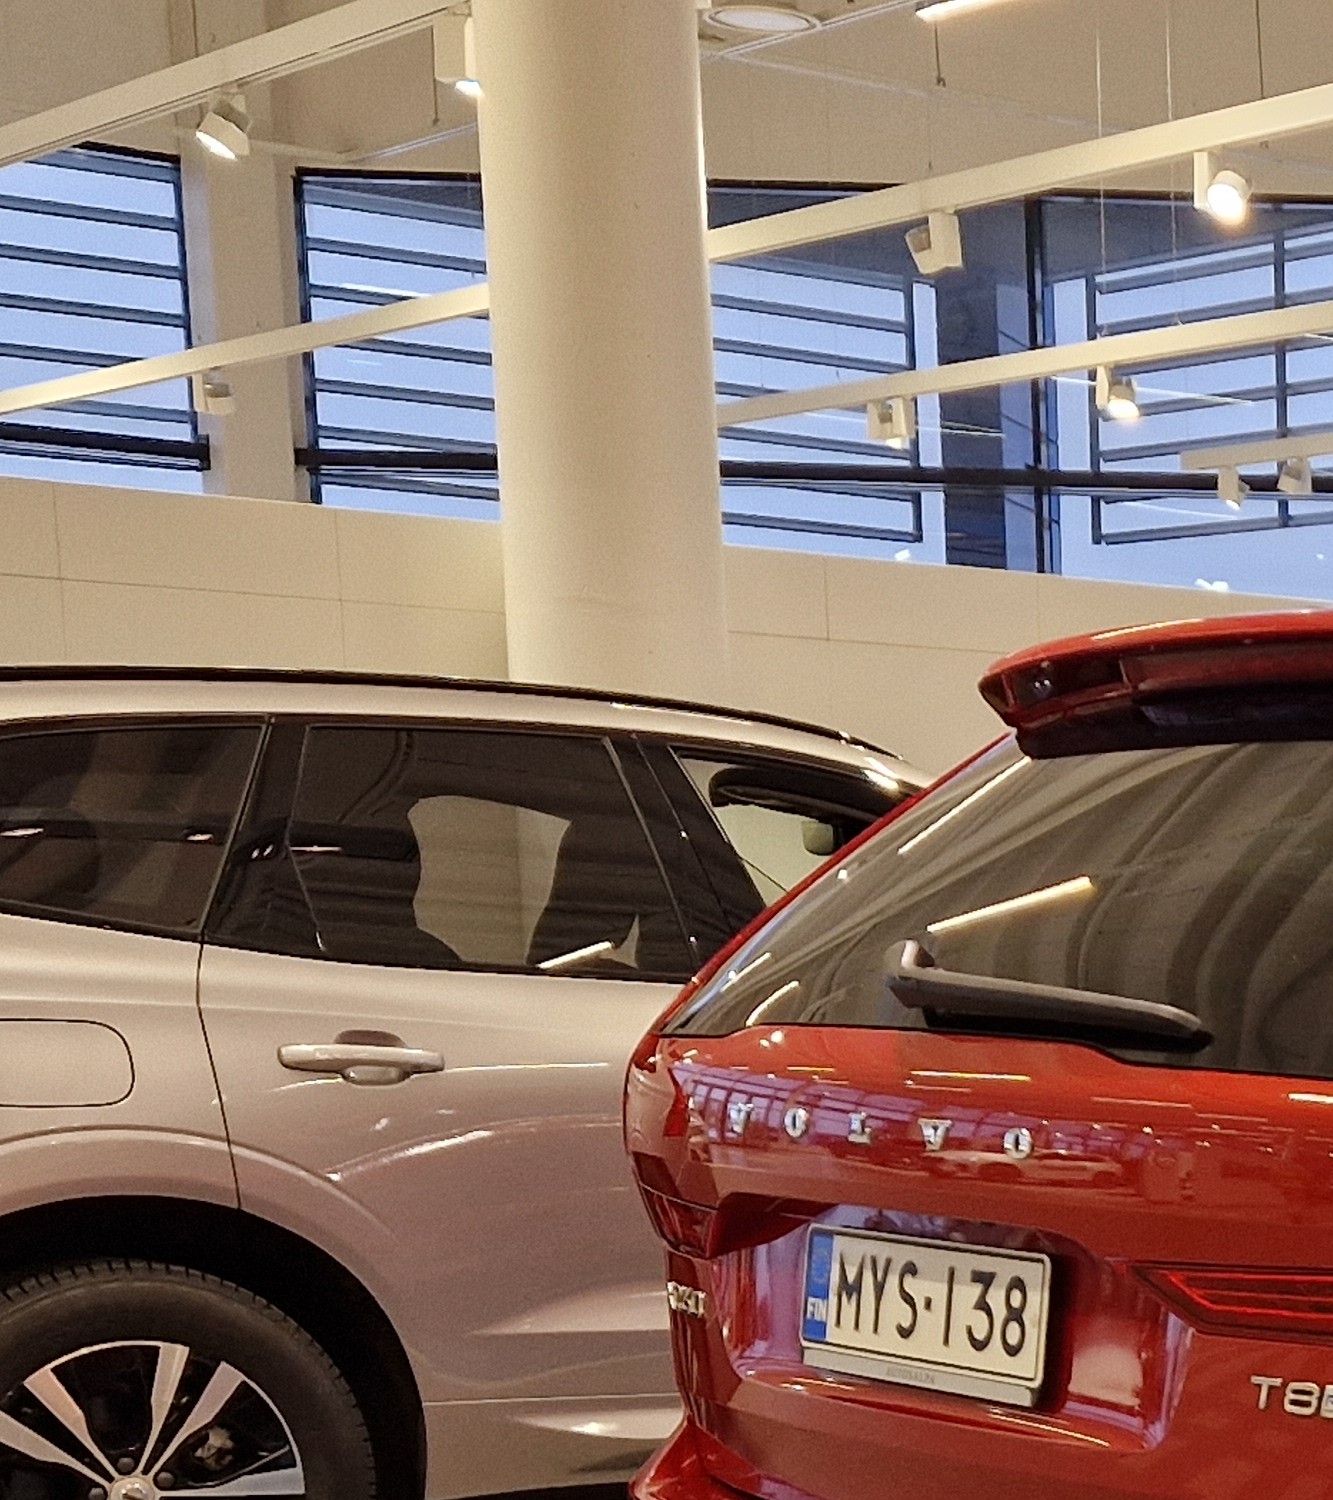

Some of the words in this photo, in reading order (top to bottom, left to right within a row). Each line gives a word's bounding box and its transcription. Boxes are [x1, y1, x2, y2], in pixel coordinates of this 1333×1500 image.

[727, 1101, 1034, 1160] VOLVO
[806, 1297, 828, 1322] FIN
[834, 1252, 1028, 1357] MYS-138
[1250, 1374, 1320, 1415] T8
